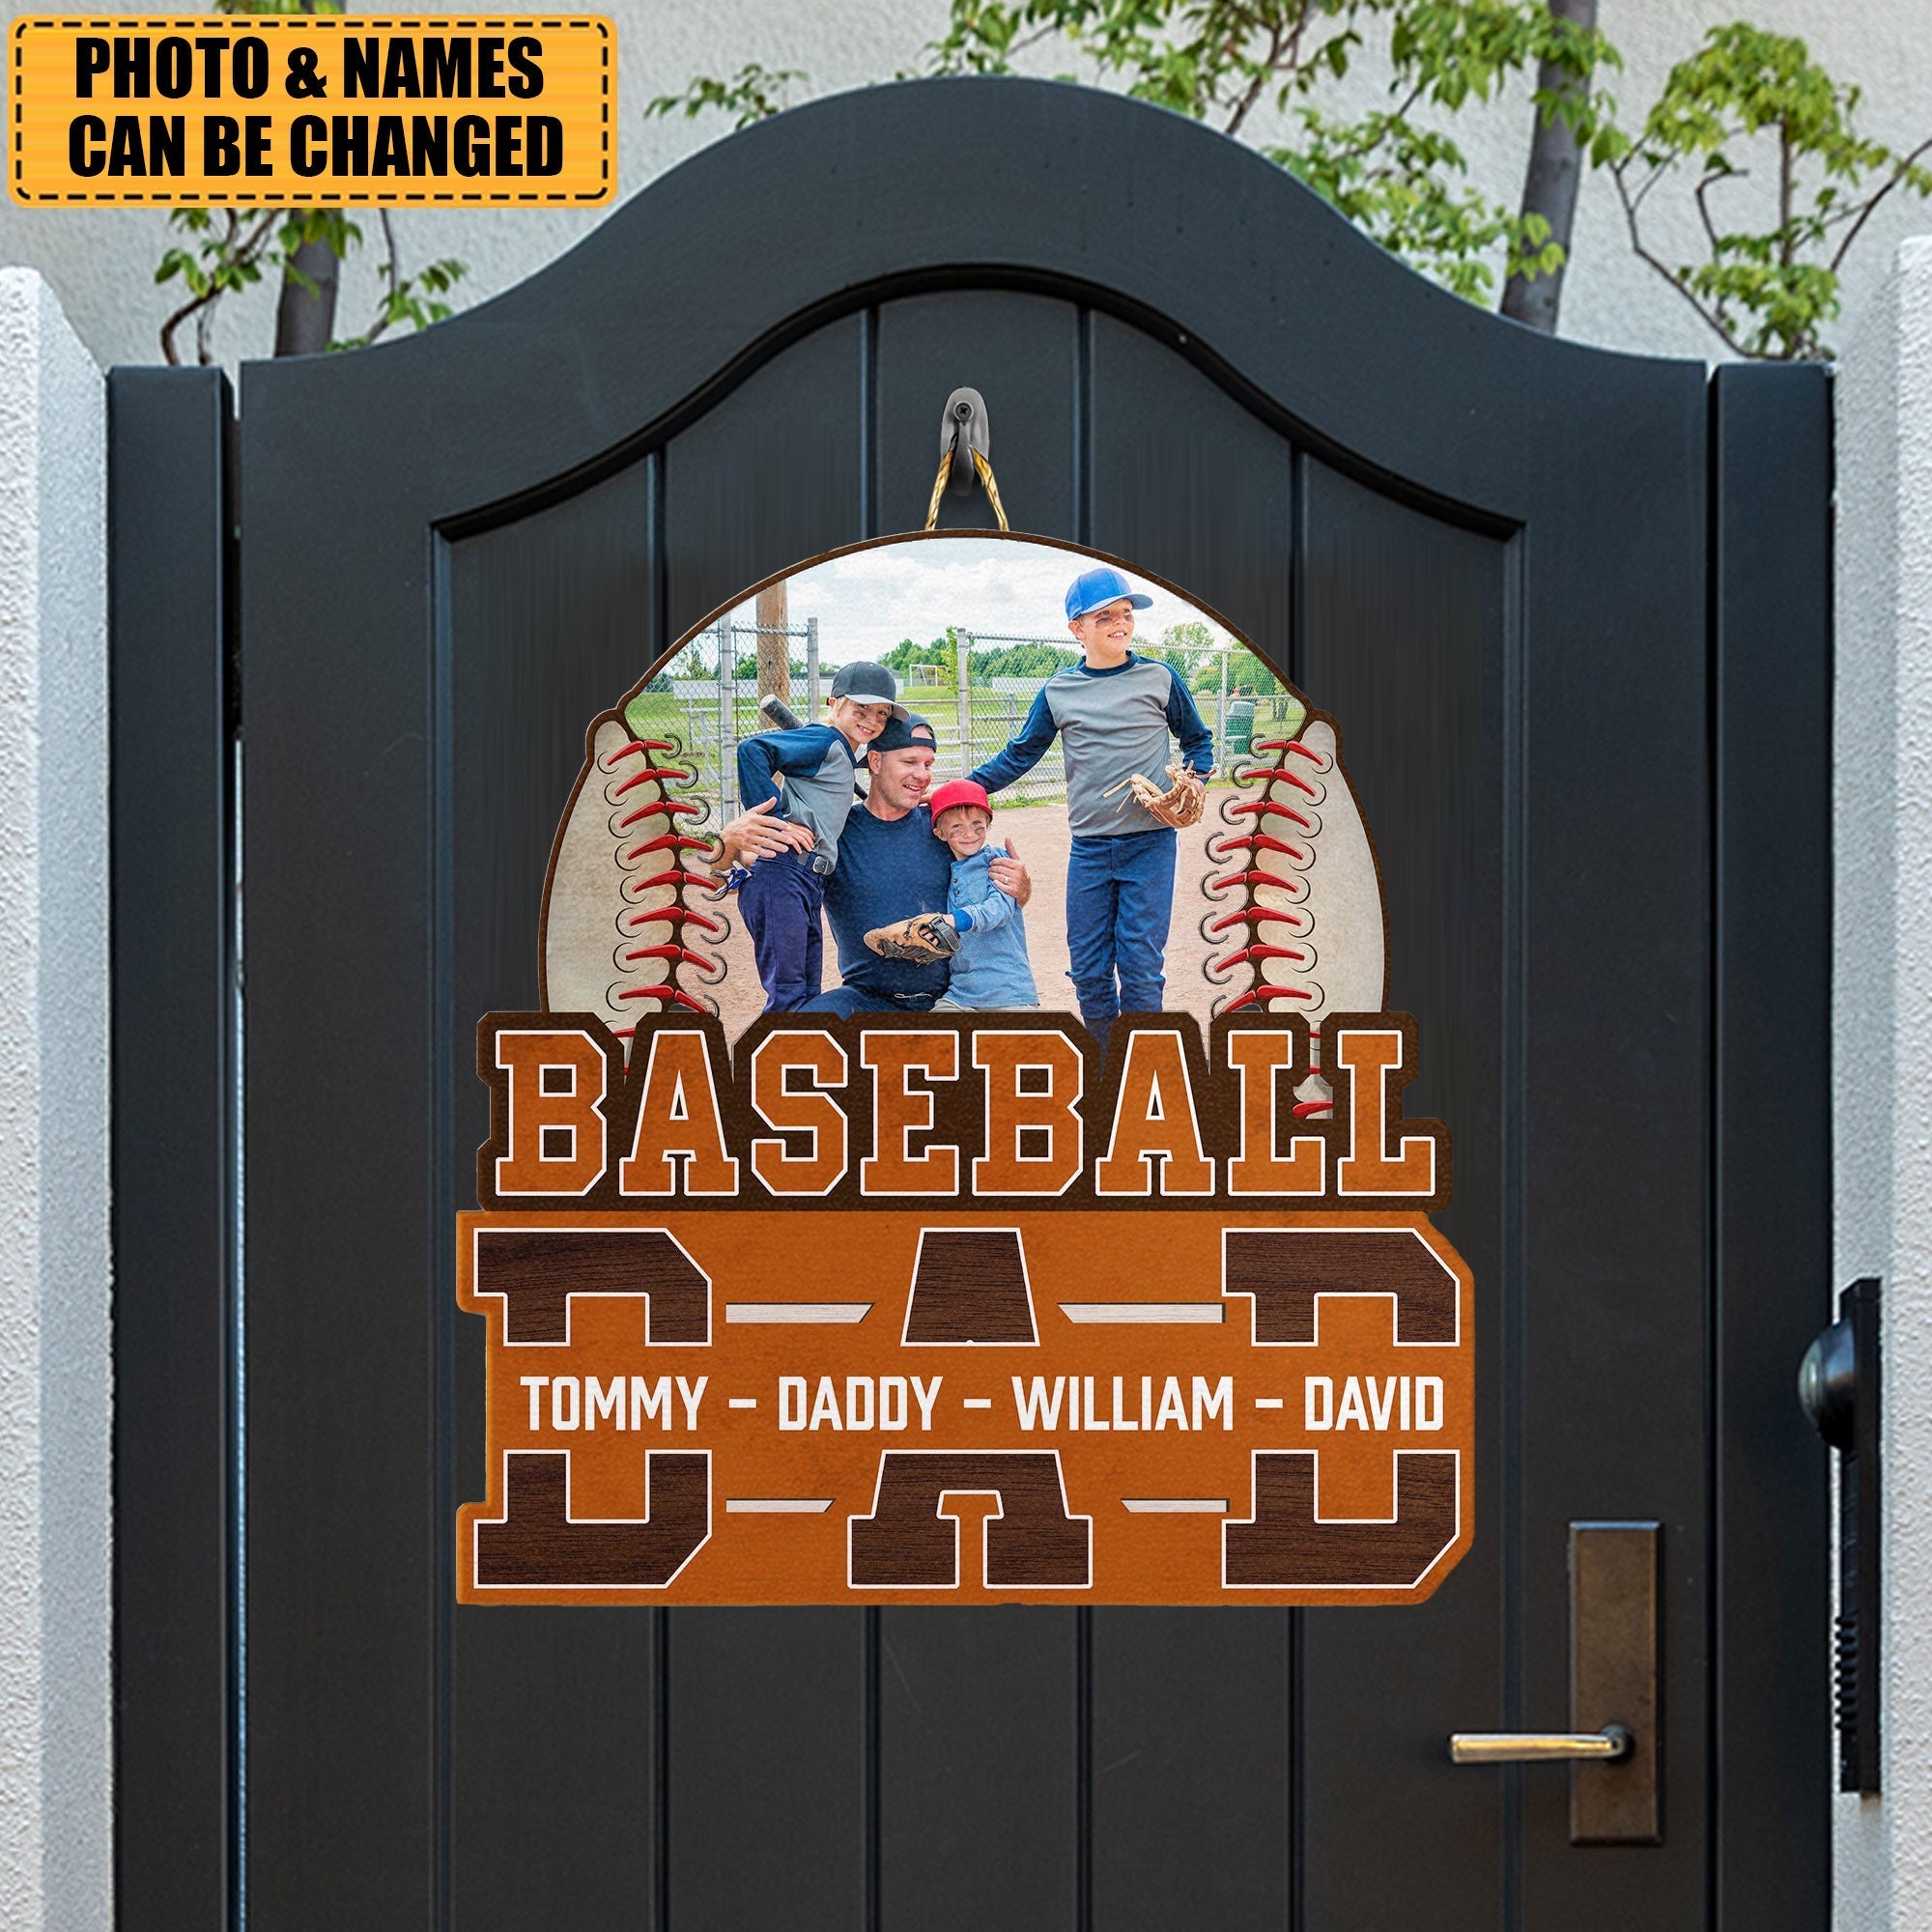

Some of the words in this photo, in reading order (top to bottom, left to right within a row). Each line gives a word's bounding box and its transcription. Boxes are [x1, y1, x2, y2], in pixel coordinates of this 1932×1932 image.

[496, 1030, 1435, 1196] BASEBALL
[520, 1376, 709, 1432] TOMMY
[728, 1398, 756, 1408] -
[778, 1376, 943, 1432] DADDY
[964, 1398, 991, 1408] -
[1011, 1376, 1234, 1432] WILLIAM
[1256, 1398, 1283, 1408] -
[1304, 1376, 1444, 1432] DAVID
